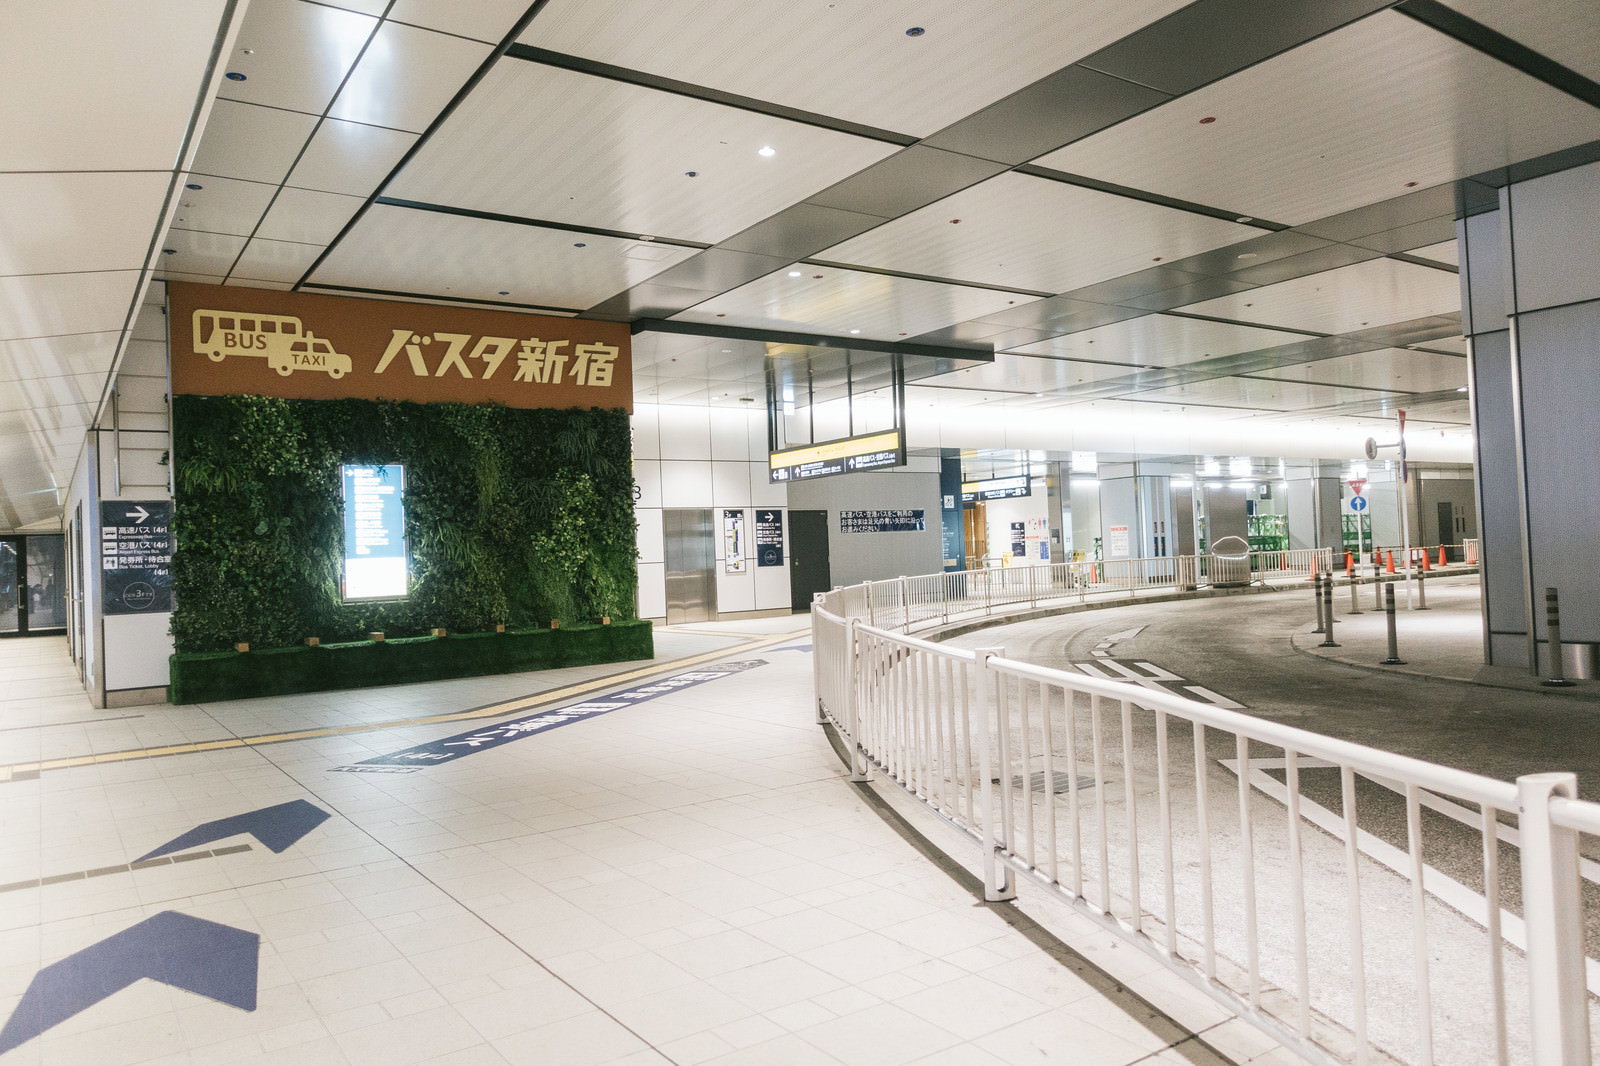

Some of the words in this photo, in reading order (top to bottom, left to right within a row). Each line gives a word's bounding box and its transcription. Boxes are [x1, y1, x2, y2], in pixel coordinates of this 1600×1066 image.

[224, 333, 267, 350] BUS
[291, 353, 326, 366] TAXI
[373, 329, 619, 387] バスタ新宿
[118, 541, 151, 550] 空港バス
[118, 556, 171, 564] 発券所・待合室
